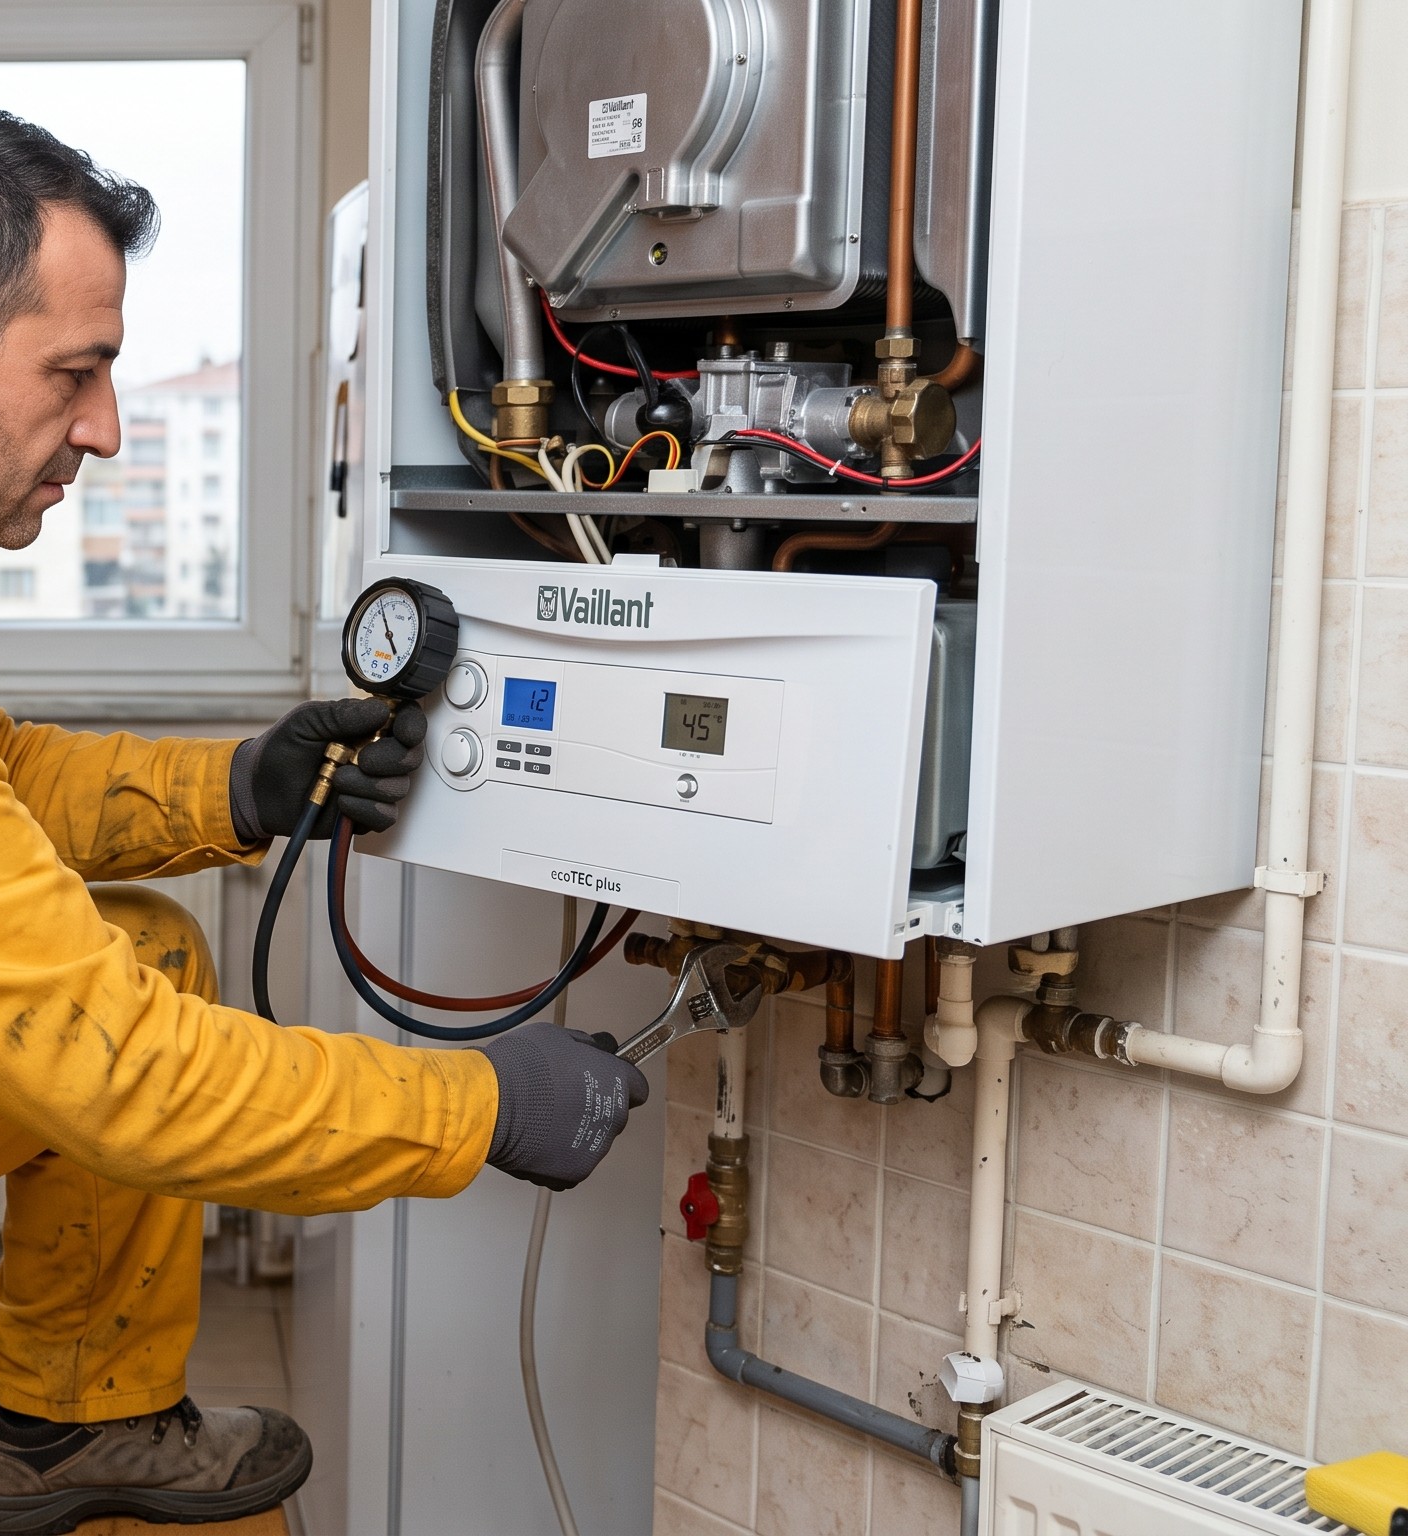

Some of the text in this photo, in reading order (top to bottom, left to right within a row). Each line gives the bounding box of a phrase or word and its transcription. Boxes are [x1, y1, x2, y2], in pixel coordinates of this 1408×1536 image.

[608, 99, 634, 112] Vaillant
[560, 586, 654, 628] Vaillant
[530, 688, 549, 711] 12
[682, 713, 711, 741] 45
[551, 870, 621, 893] ecoTEC plus
